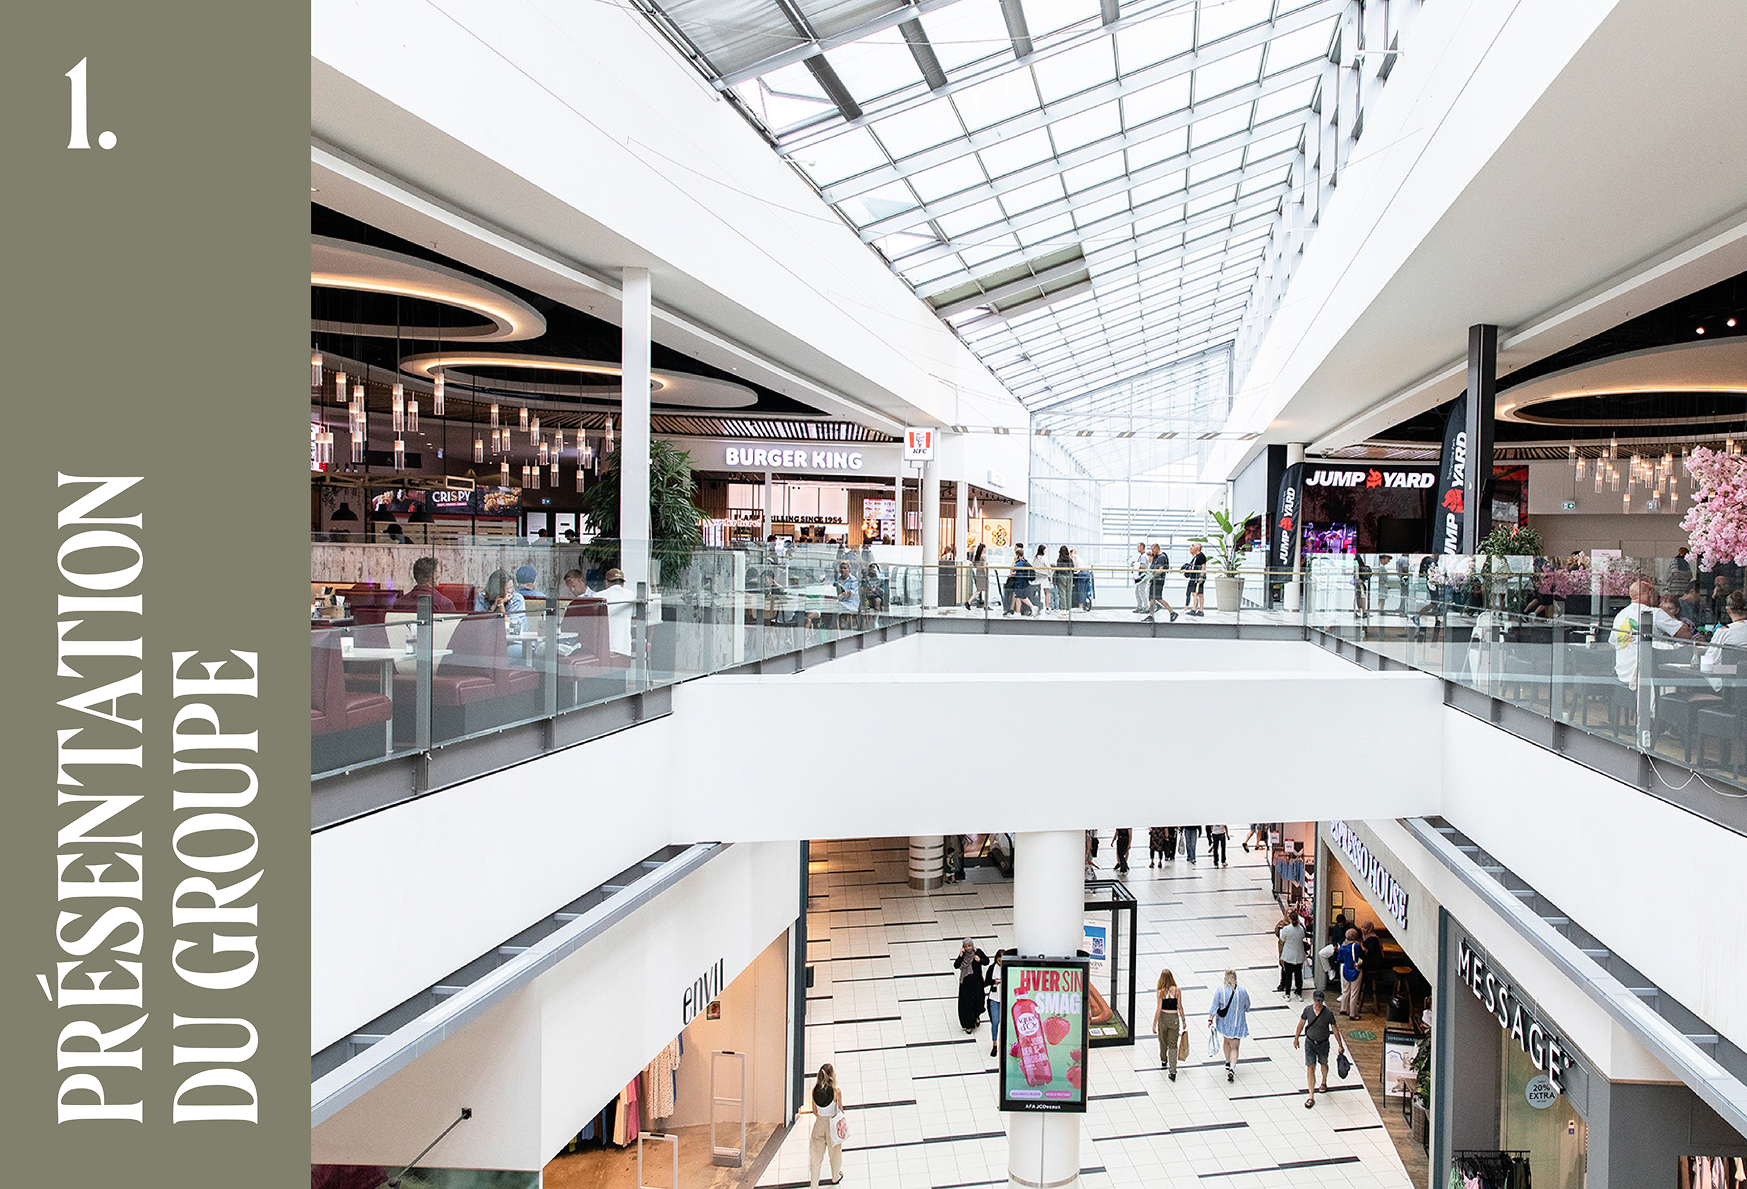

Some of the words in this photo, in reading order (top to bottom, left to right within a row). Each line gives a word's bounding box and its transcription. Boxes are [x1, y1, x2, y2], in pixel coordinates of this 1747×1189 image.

[725, 447, 808, 469] BURGER
[811, 450, 863, 470] KING
[1450, 431, 1468, 488] YARD
[1305, 470, 1366, 487] JUMP
[1382, 472, 1436, 488] YARD
[431, 490, 471, 502] CRISPY
[1283, 487, 1296, 517] YARD
[800, 515, 824, 523] SINCE
[1280, 530, 1290, 565] JUMP
[1367, 854, 1409, 930] HOUSE
[1020, 970, 1060, 992] HVER
[1062, 970, 1082, 992] SIN
[1034, 992, 1081, 1015] SMAG
[1529, 1092, 1556, 1100] EXTRA
